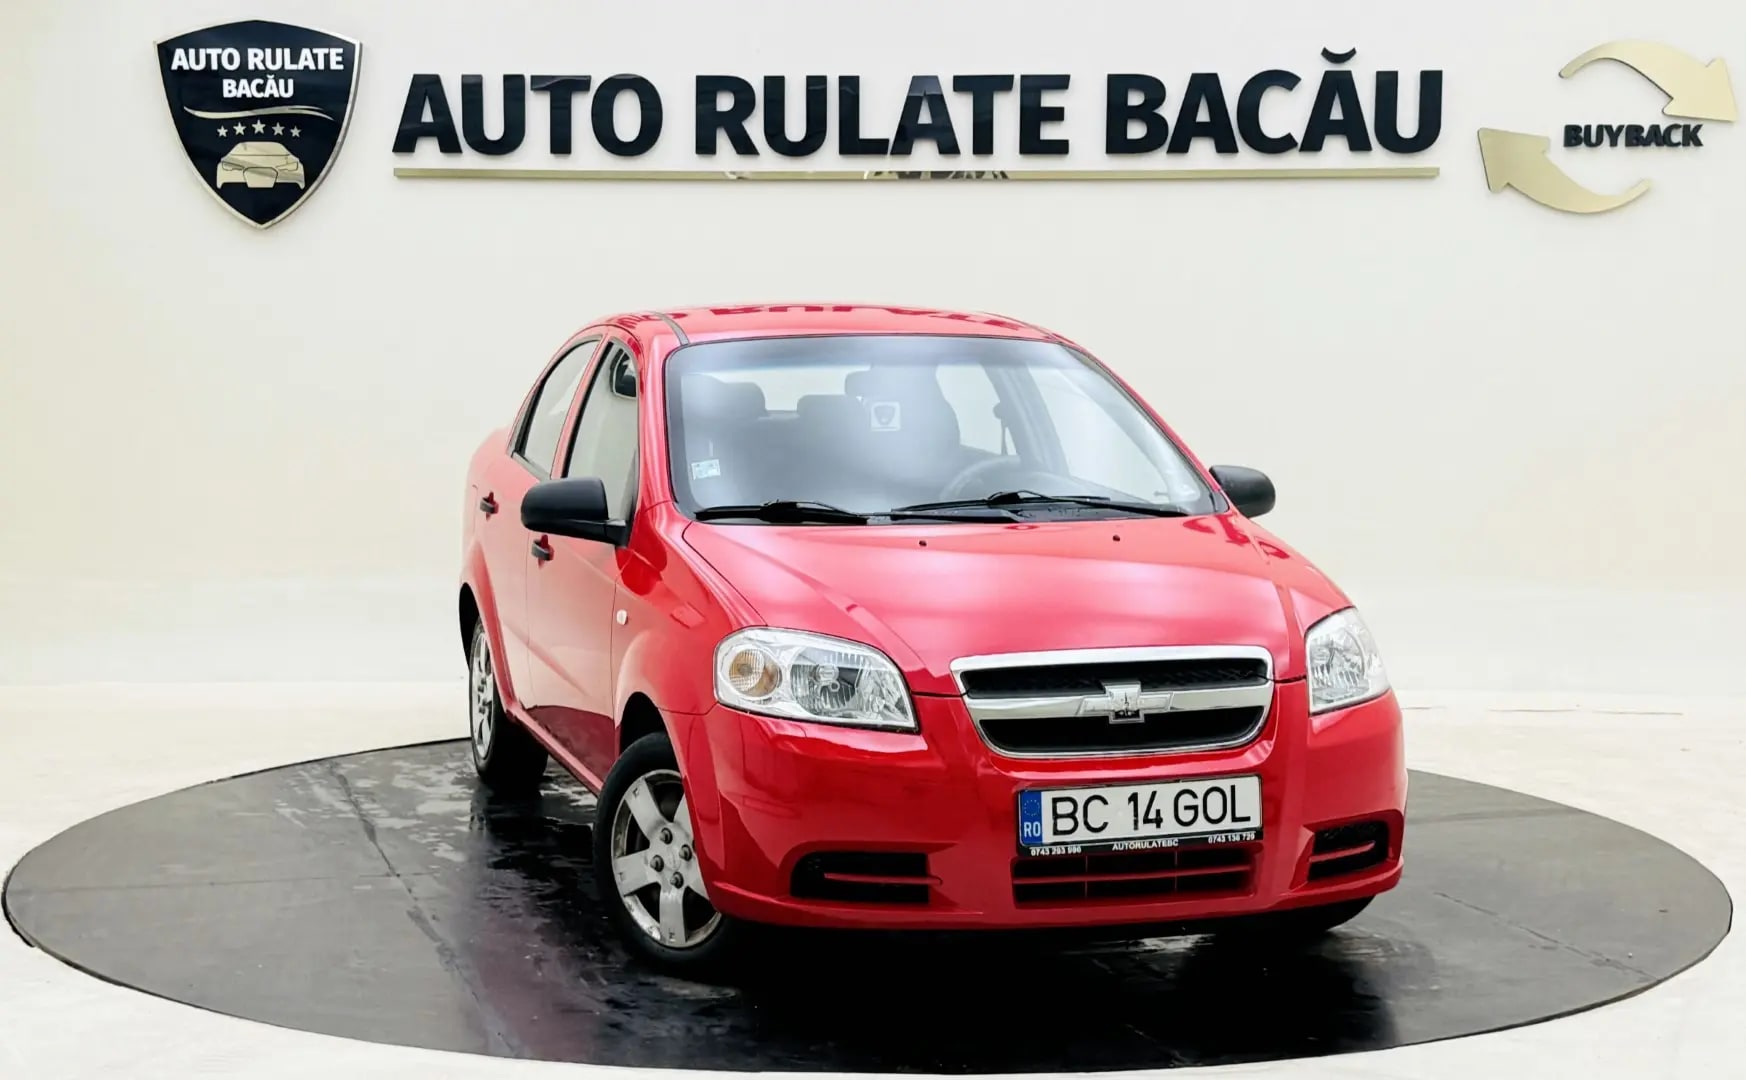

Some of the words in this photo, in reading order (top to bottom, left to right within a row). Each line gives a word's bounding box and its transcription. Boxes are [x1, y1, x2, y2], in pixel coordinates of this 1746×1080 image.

[170, 47, 241, 71] AUTO
[247, 47, 345, 71] RULATE
[222, 74, 295, 98] BACĂU
[391, 73, 663, 156] AUTO
[695, 74, 1071, 156] RULATE
[1105, 46, 1443, 155] BACĂU
[1563, 124, 1704, 148] BUYBACK
[1051, 794, 1110, 836] BC
[1127, 790, 1164, 831] 14
[1173, 784, 1251, 828] GOL
[1023, 821, 1042, 838] RO
[1112, 840, 1179, 850] AUTORULATEBC
